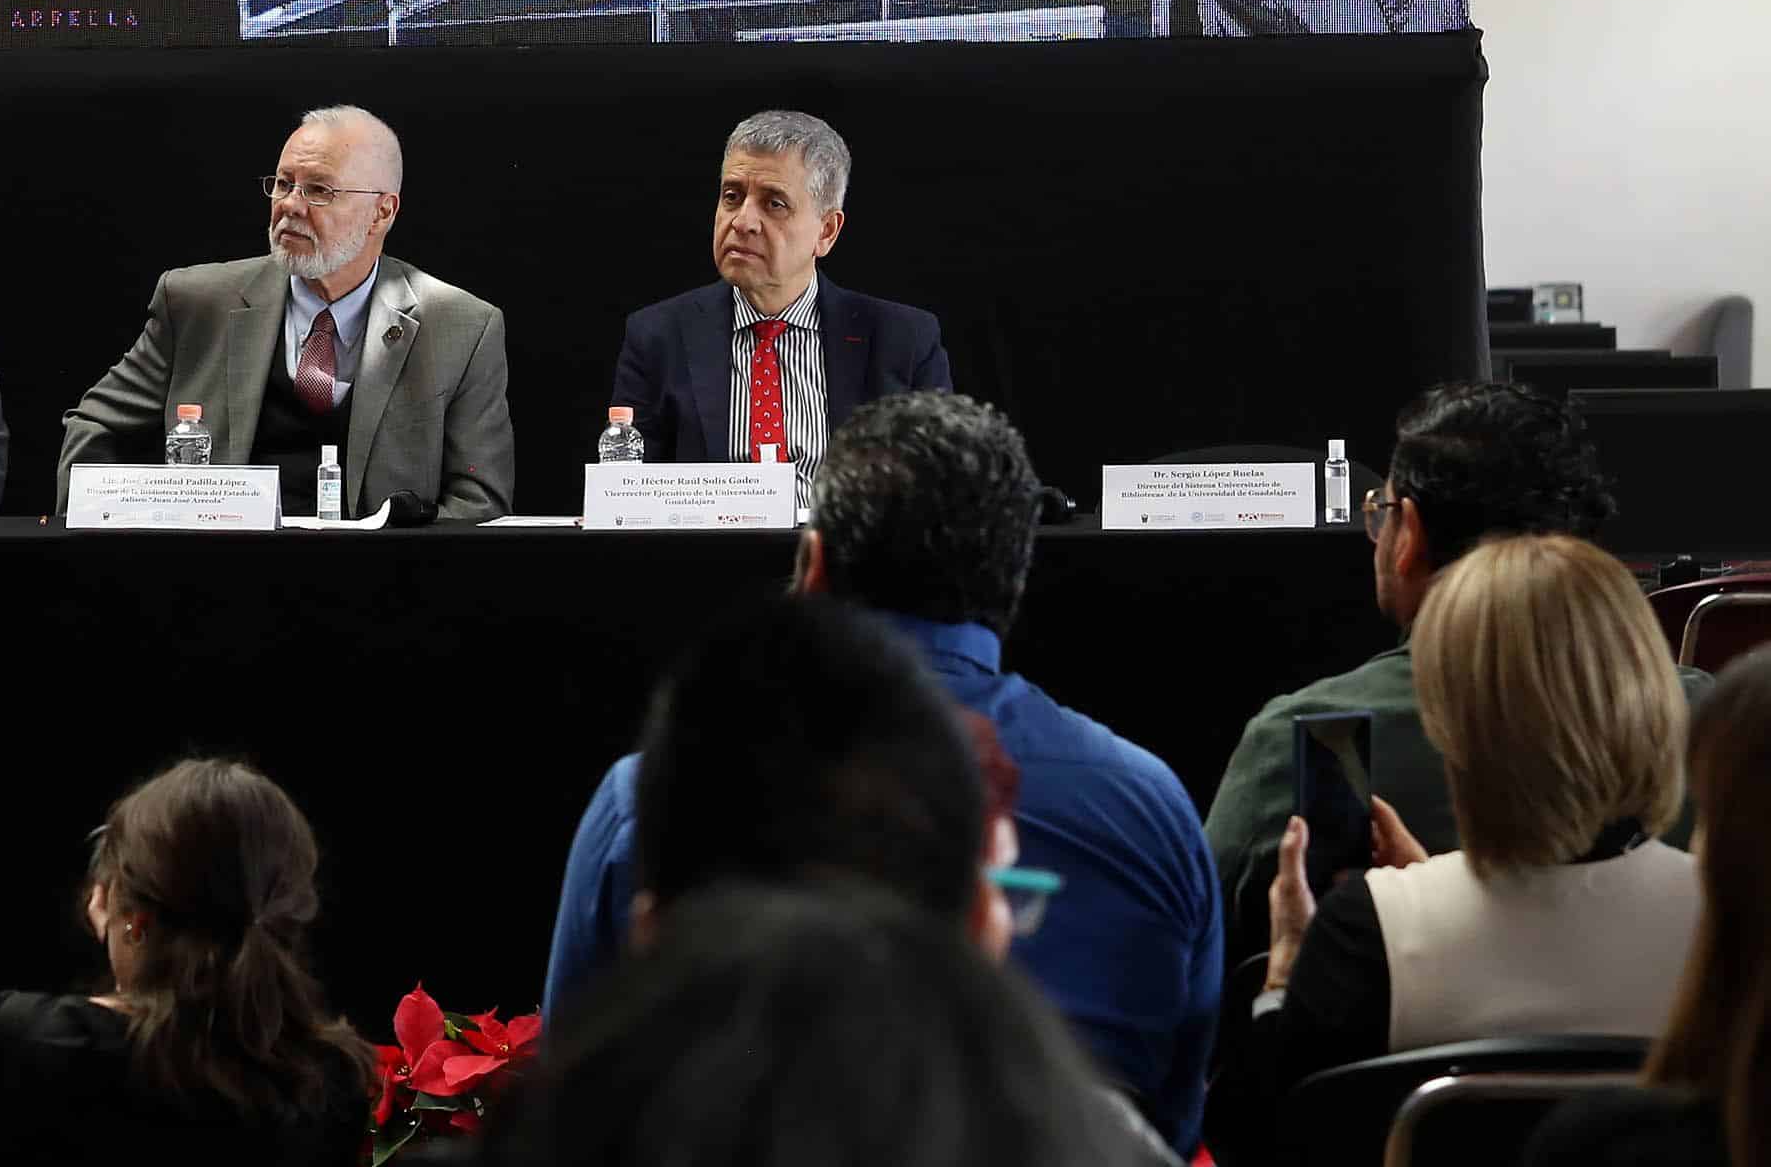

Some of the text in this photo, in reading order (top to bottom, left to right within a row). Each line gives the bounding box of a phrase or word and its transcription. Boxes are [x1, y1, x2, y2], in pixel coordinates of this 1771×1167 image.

[1170, 470, 1201, 480] Sergio
[1202, 470, 1231, 479] López
[185, 478, 216, 486] Padilla
[622, 478, 638, 486] Dr.
[640, 477, 676, 486] Héctor
[728, 476, 760, 484] Gadea
[1136, 482, 1170, 490] Director
[1217, 481, 1270, 489] Universitario
